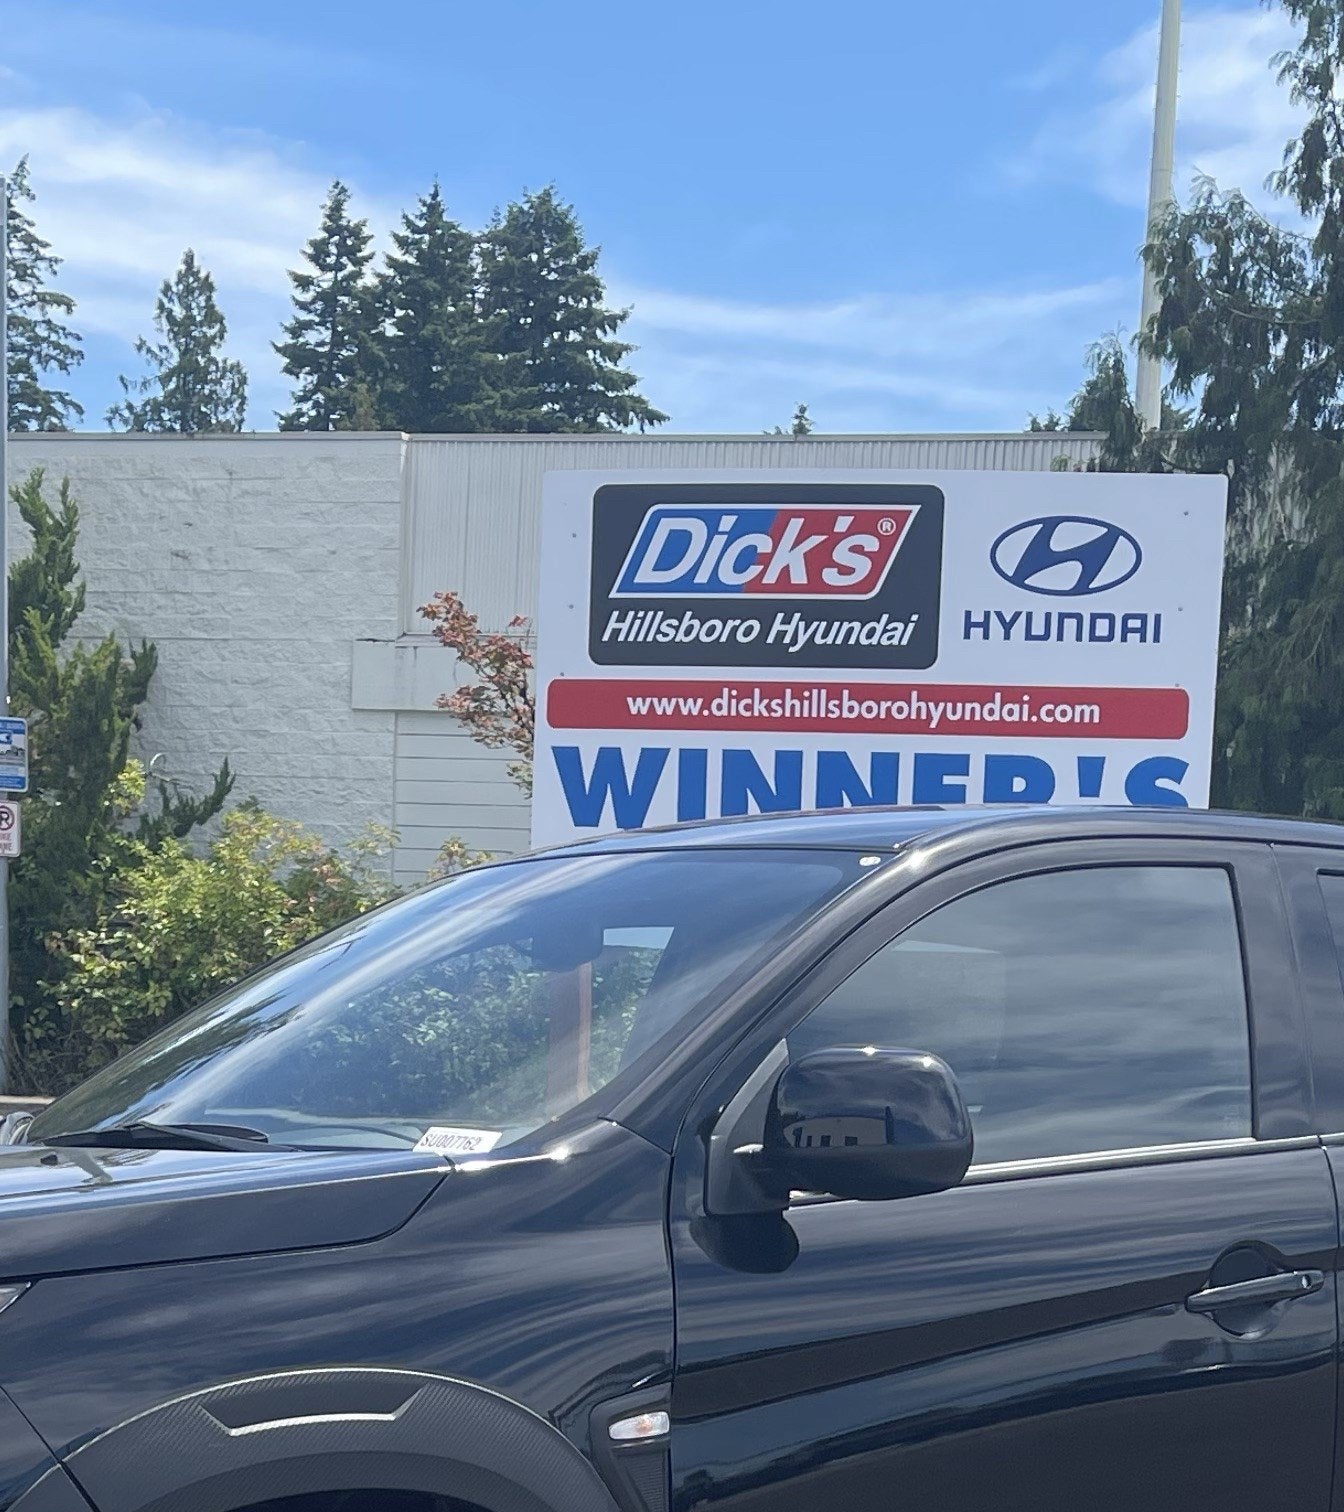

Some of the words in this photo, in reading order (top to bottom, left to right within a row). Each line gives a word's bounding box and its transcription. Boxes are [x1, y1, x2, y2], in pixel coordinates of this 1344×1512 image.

[633, 514, 882, 587] Dick's
[601, 610, 761, 646] Hillsboro
[764, 612, 919, 653] Hyundai
[964, 609, 1161, 644] HYUNDAI
[626, 688, 1101, 728] www.dickshillsborohyundai.com
